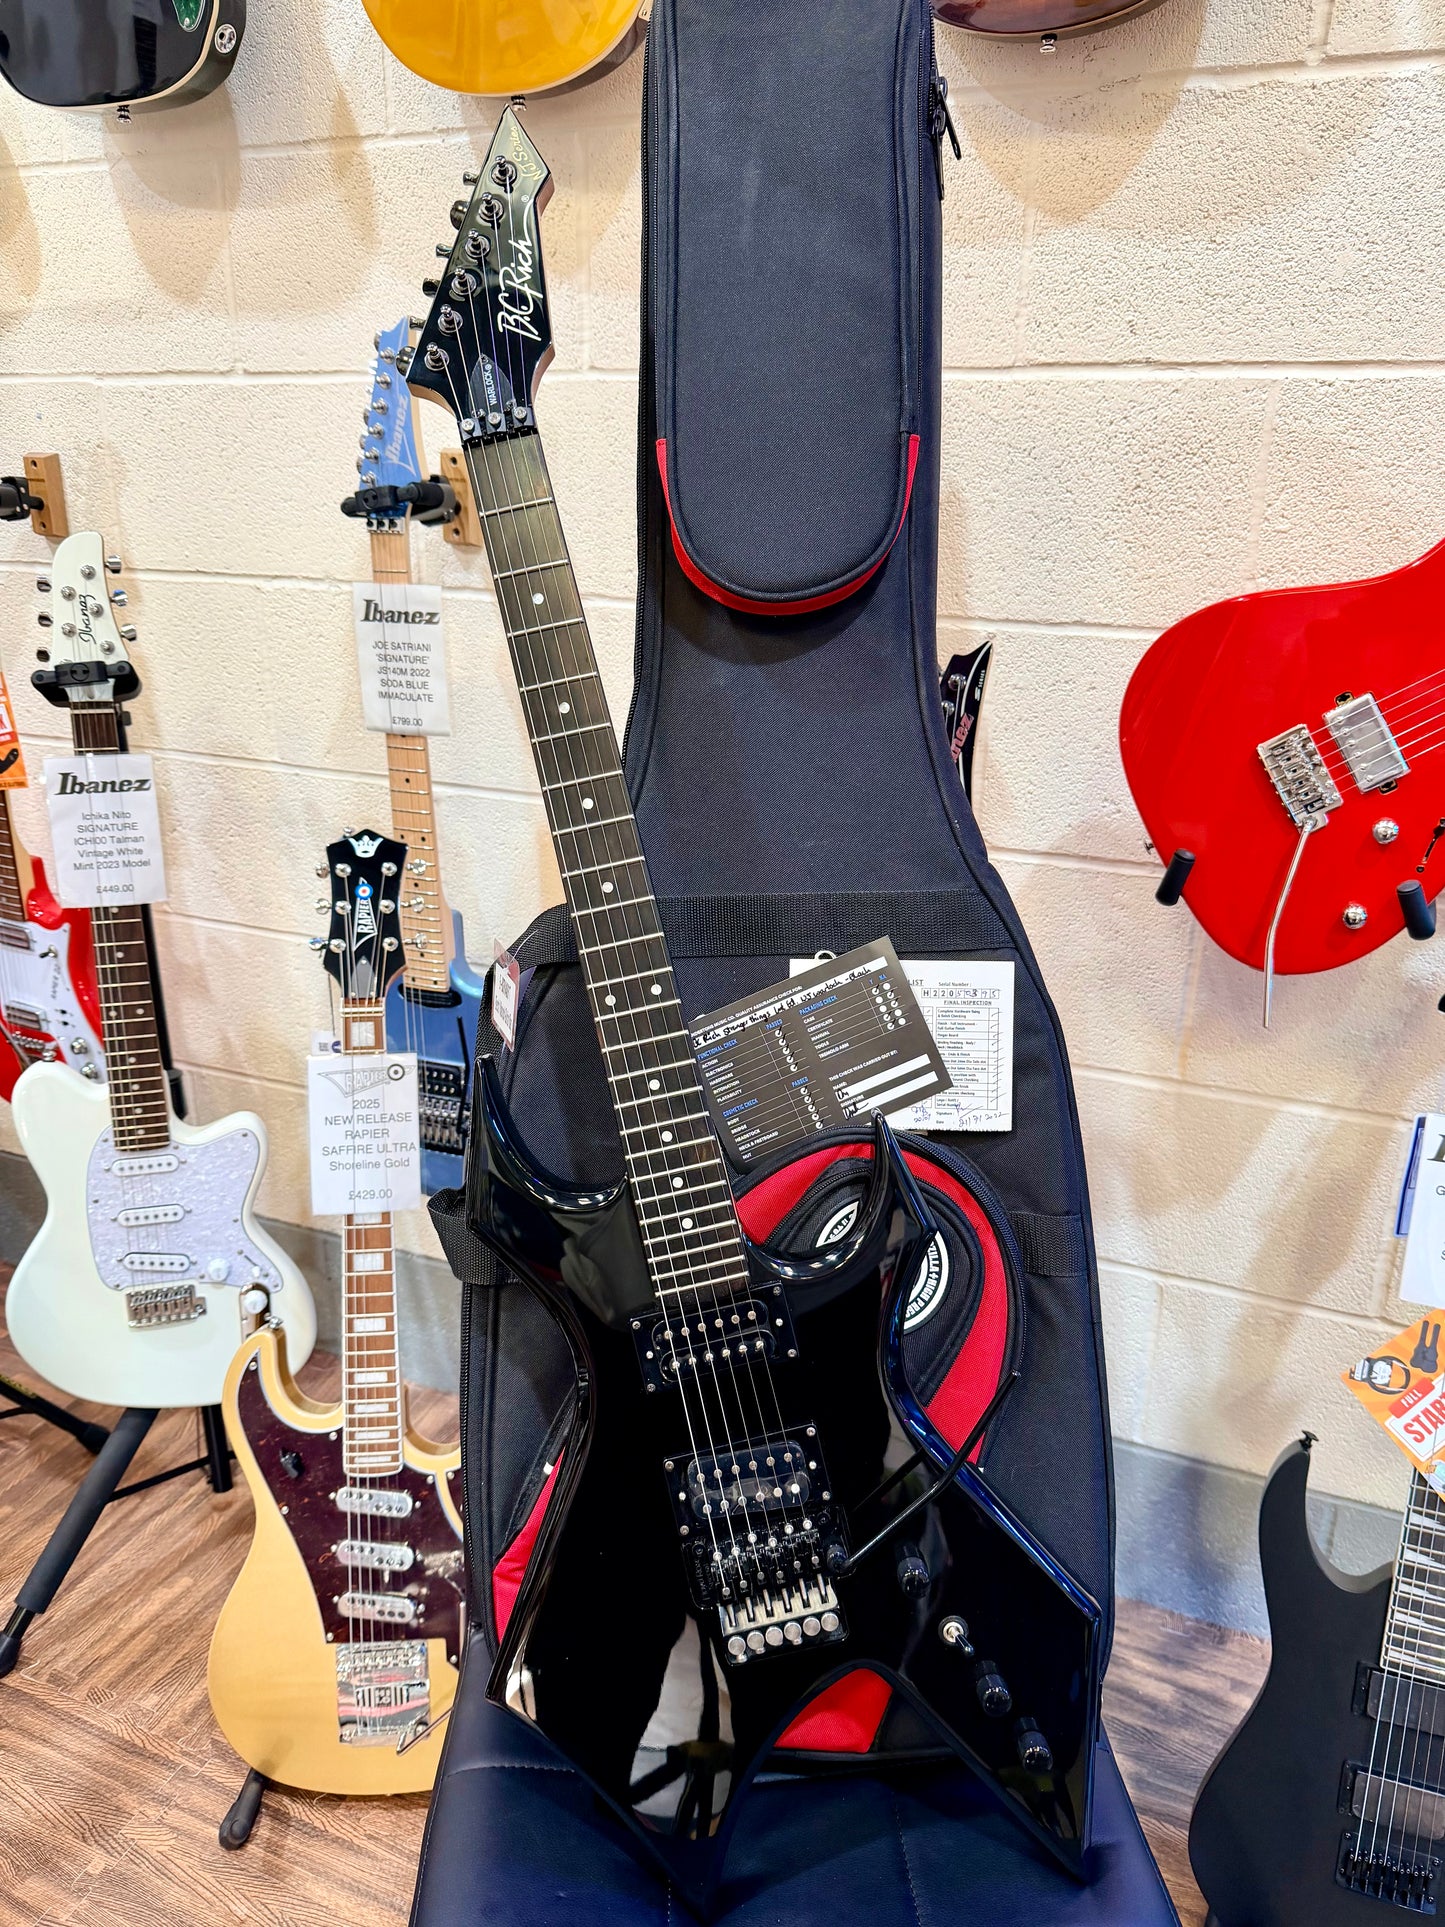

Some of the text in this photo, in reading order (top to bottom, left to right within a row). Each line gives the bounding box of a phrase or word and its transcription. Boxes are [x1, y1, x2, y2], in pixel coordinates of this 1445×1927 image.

[385, 393, 408, 464] Ibanez
[360, 599, 440, 625] Ibanez
[372, 641, 432, 652] JOE SATRIANI
[378, 666, 431, 678] JS140M 2022
[380, 678, 429, 690] SODA BLUE
[378, 691, 434, 703] IMMACULATE
[392, 716, 423, 727] £799.00
[54, 772, 152, 796] Ibanez
[82, 811, 131, 821] Ichika Nito
[77, 822, 139, 833] SIGNATURE
[110, 835, 145, 844] Talman
[78, 848, 144, 859] Vintage White
[74, 858, 151, 871] Mint 2023 Model
[96, 884, 134, 894] £449.00
[357, 899, 375, 934] RAPIER
[735, 1006, 753, 1017] QUALITY
[701, 1028, 721, 1043] Rich
[353, 1099, 380, 1110] 2025
[325, 1112, 412, 1126] NEW RELEASE
[345, 1128, 390, 1140] RAPIER
[322, 1142, 417, 1156] SAFFIRE ULTRA
[329, 1158, 410, 1171] Shoreline Gold
[348, 1189, 393, 1201] £429.00
[920, 1279, 937, 1301] HIGH
[1400, 1389, 1422, 1408] FULL
[1403, 1392, 1445, 1443] STAR
